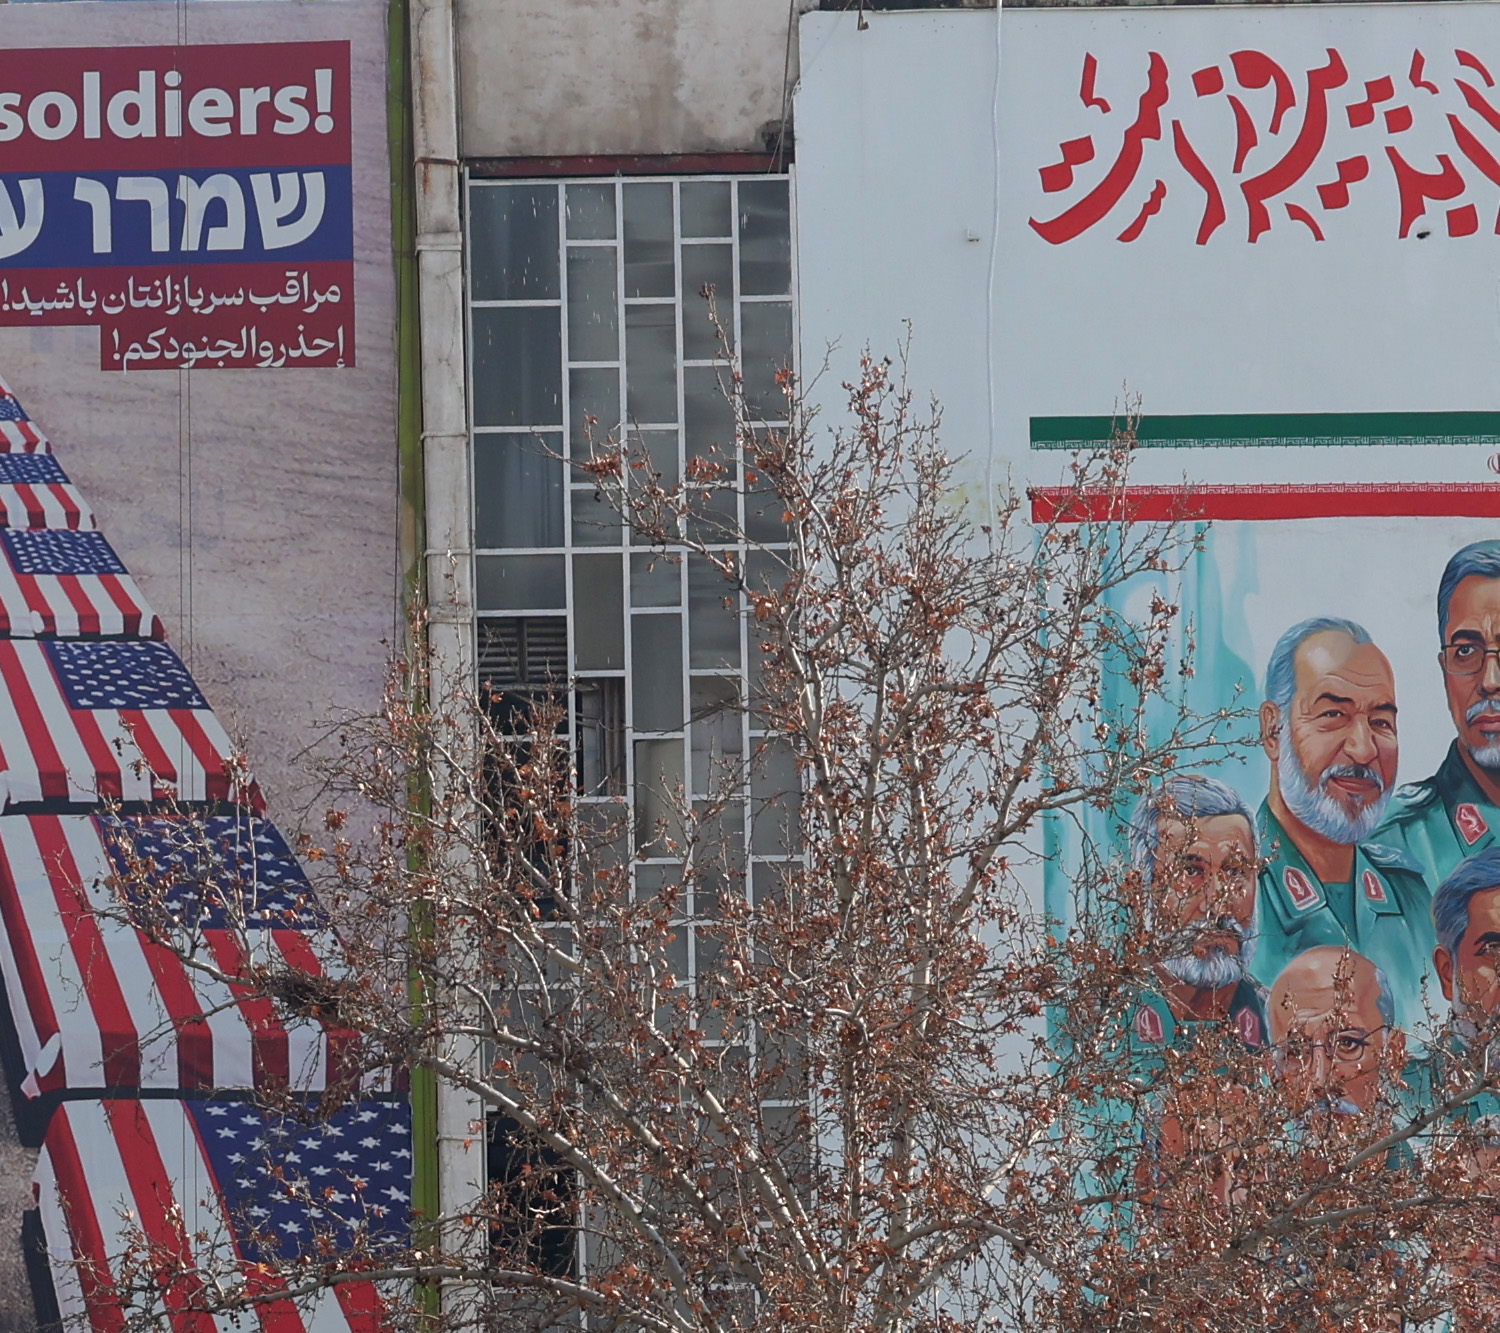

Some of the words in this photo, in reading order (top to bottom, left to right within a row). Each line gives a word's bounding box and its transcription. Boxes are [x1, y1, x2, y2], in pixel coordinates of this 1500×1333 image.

[74, 166, 328, 257] שמרו
[0, 276, 98, 316] باشید!
[101, 273, 245, 317] سربازانتان
[248, 270, 342, 315] مراقب
